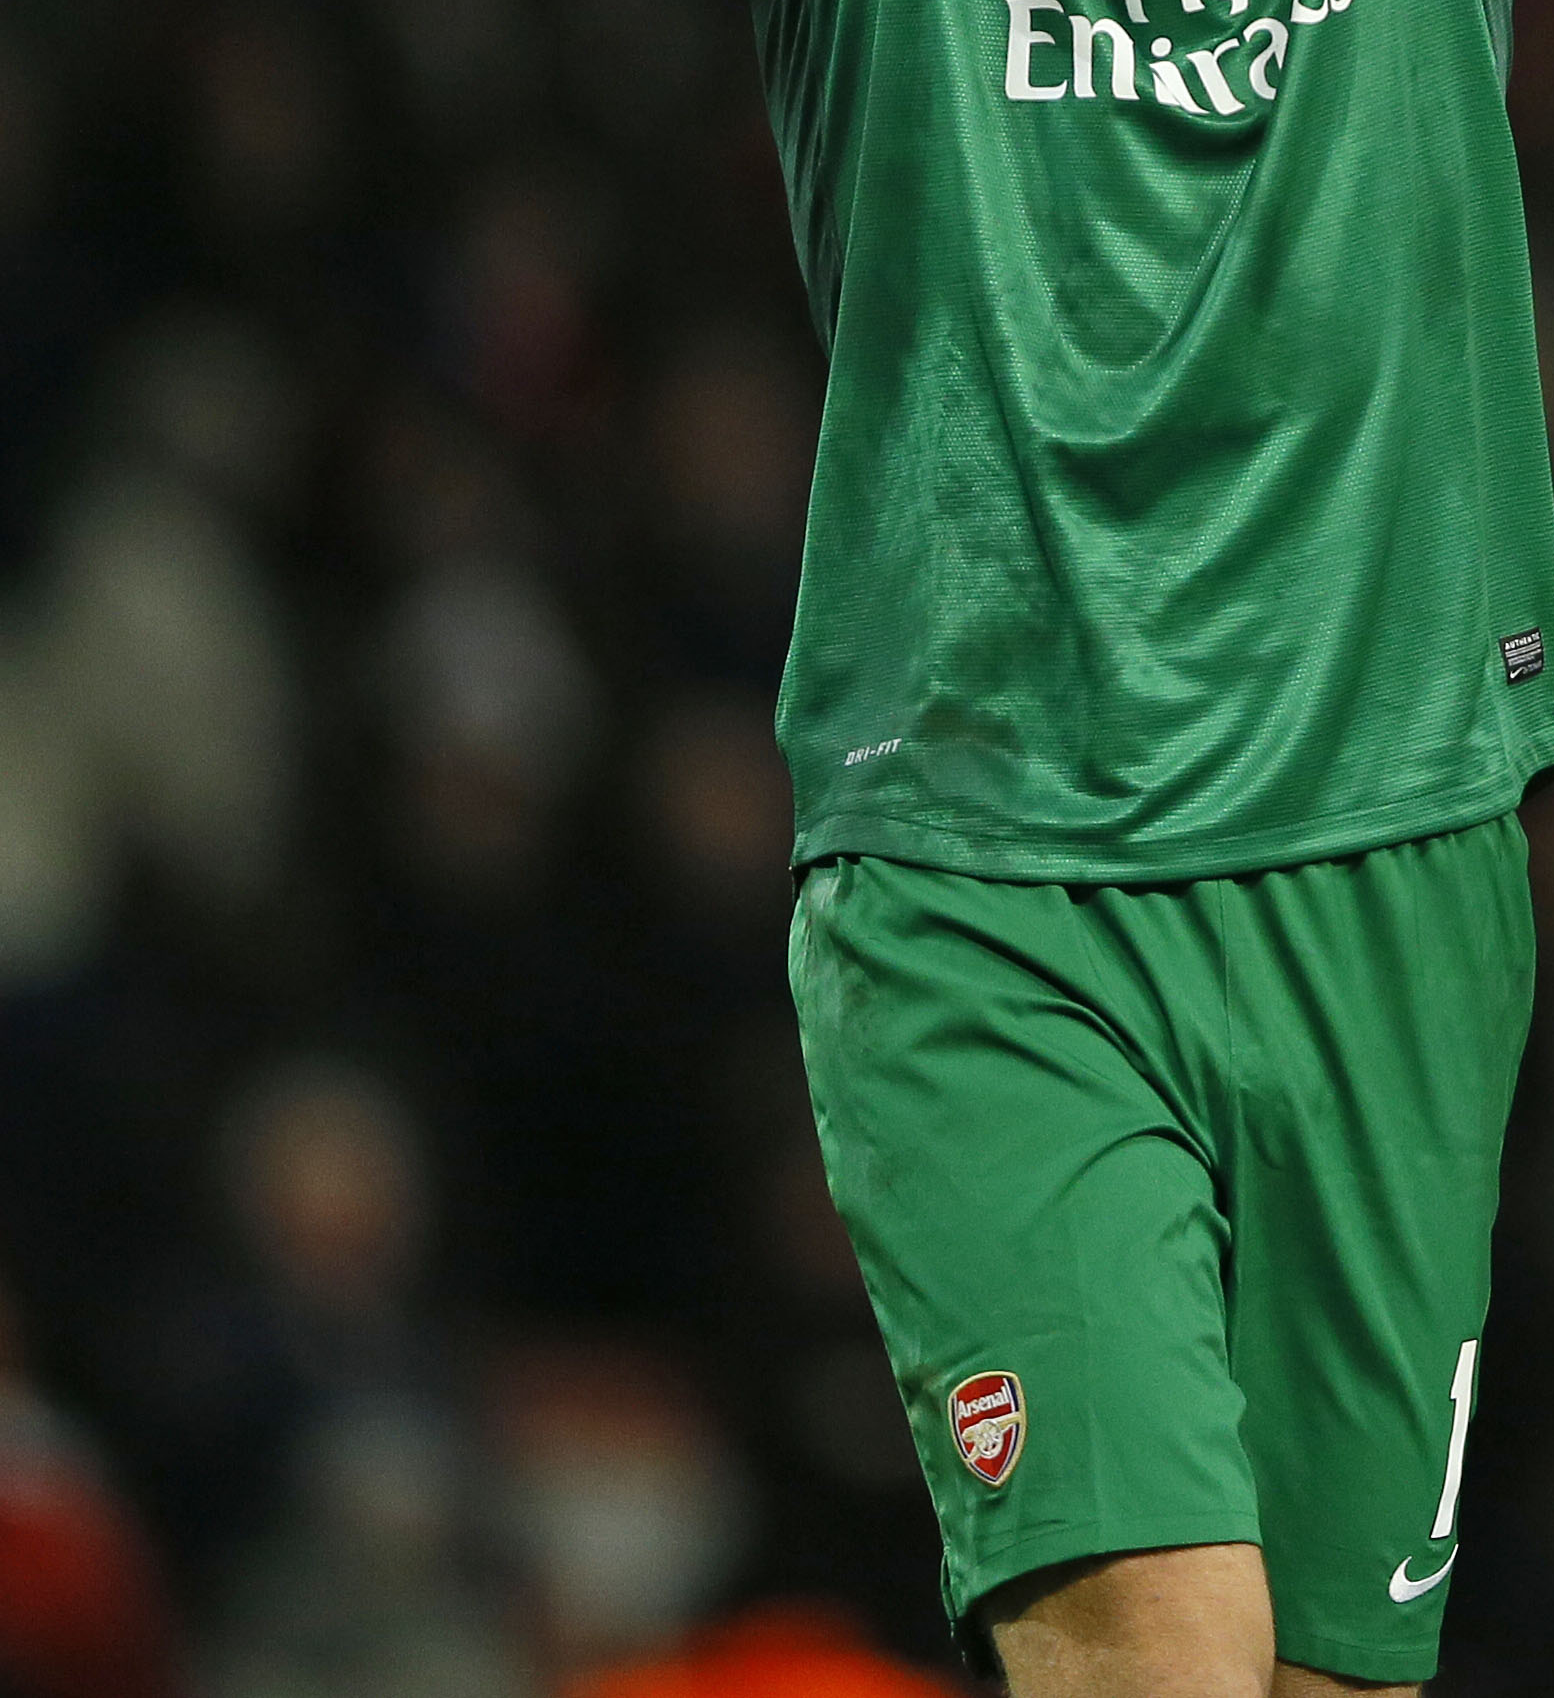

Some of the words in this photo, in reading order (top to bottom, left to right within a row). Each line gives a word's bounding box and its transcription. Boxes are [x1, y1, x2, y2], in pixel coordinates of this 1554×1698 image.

[844, 737, 902, 767] DRI-FIT
[958, 1385, 1010, 1420] Arsenal
[1429, 1338, 1479, 1540] 1
